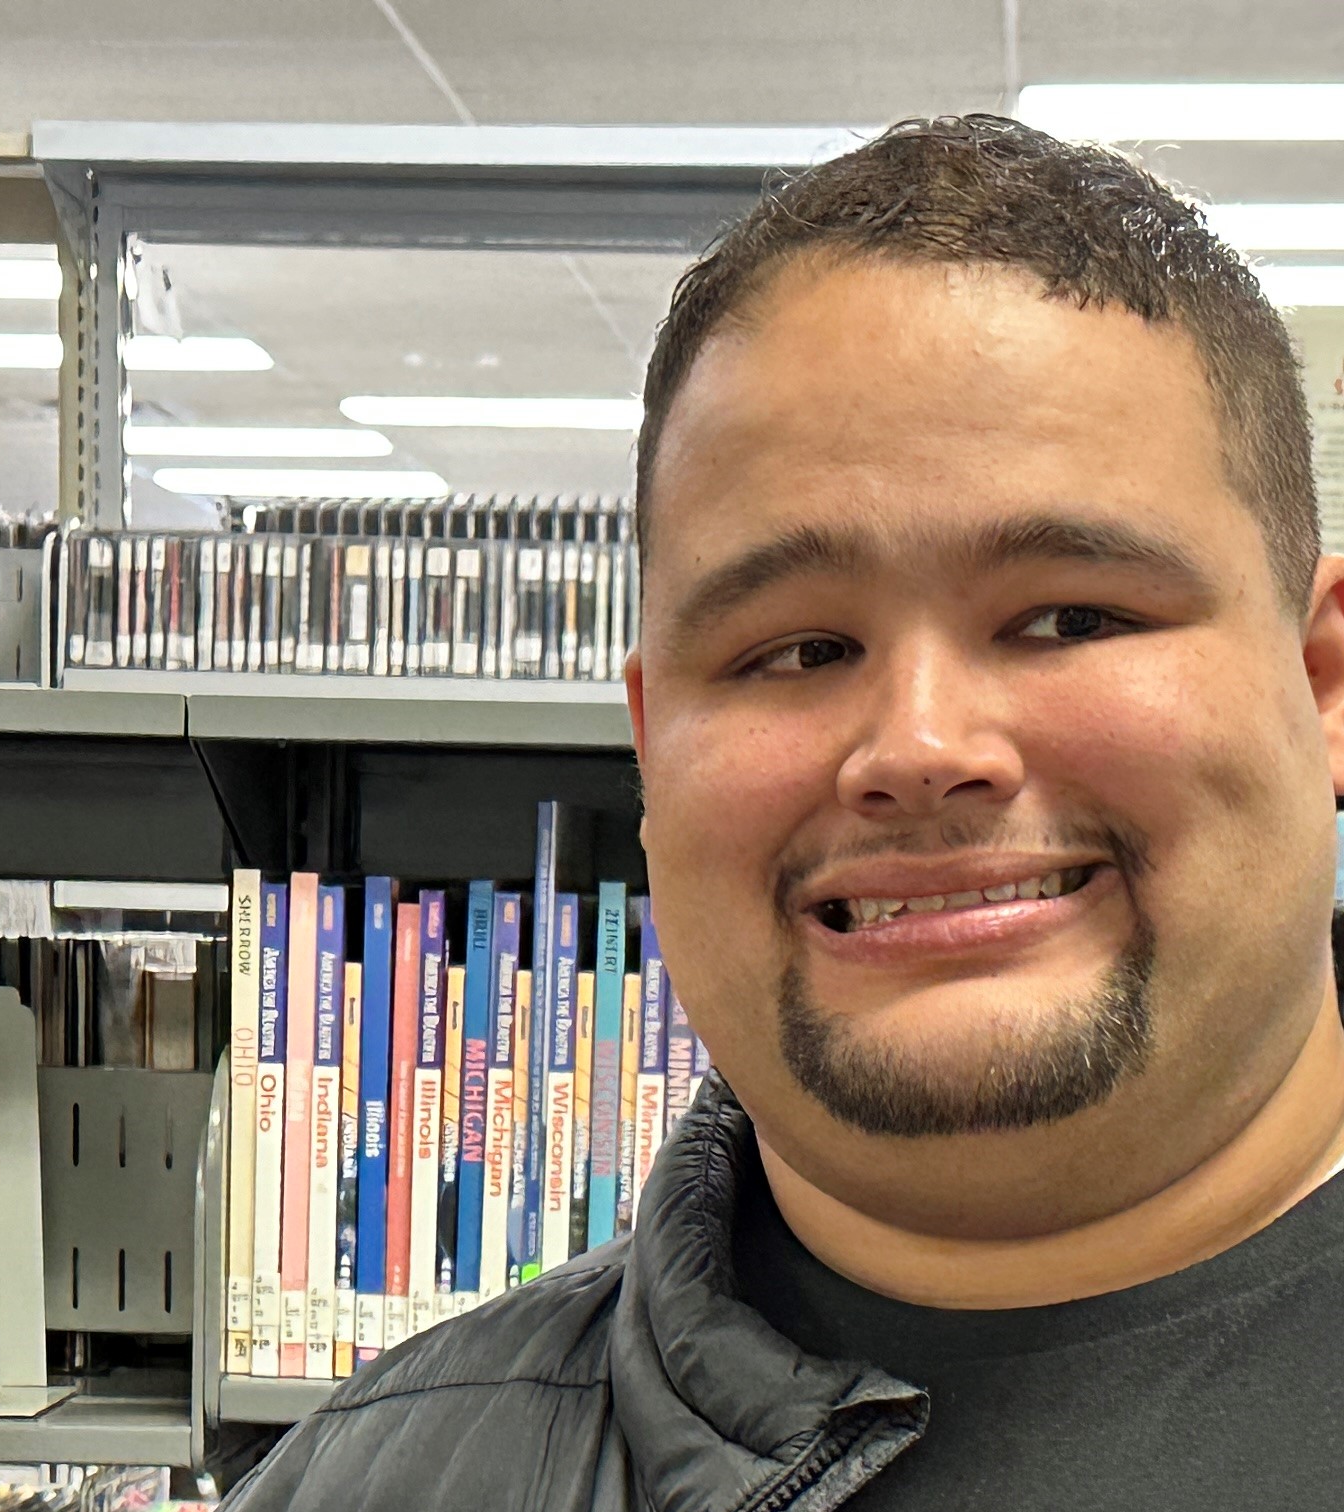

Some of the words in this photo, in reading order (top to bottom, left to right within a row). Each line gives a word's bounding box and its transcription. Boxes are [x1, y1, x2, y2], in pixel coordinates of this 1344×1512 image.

[238, 893, 253, 977] SHERROW
[233, 1027, 255, 1087] OHIO
[462, 1038, 487, 1163] MICHIGAN
[259, 1074, 277, 1133] Ohio
[316, 1077, 334, 1169] Indiana
[364, 1099, 386, 1158] Illinois
[419, 1079, 436, 1160] Illinois
[488, 1080, 513, 1198] Michigan
[548, 1083, 570, 1212] Wisconsin
[640, 1084, 659, 1184] Minnes
